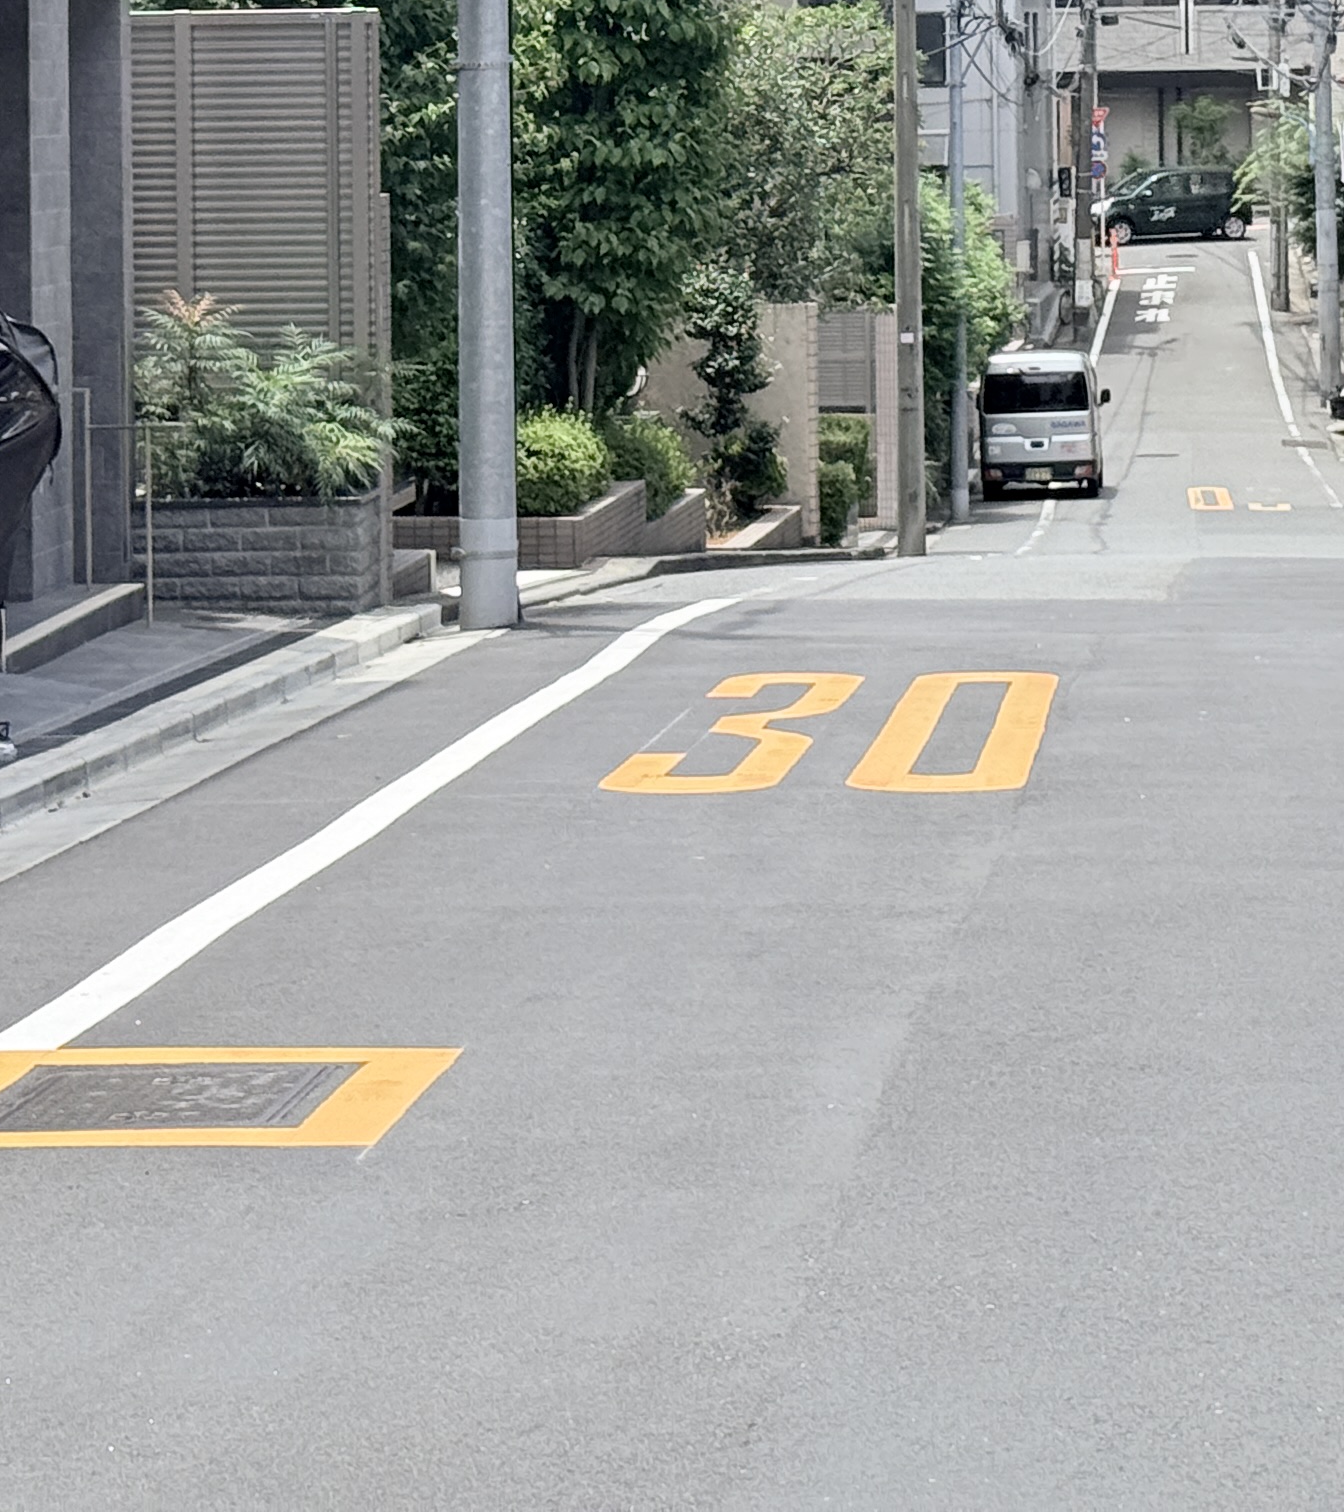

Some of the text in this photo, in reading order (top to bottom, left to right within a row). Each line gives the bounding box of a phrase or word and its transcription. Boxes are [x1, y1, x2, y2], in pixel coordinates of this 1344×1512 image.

[1135, 274, 1178, 322] 止まれ
[597, 670, 1060, 794] 30
